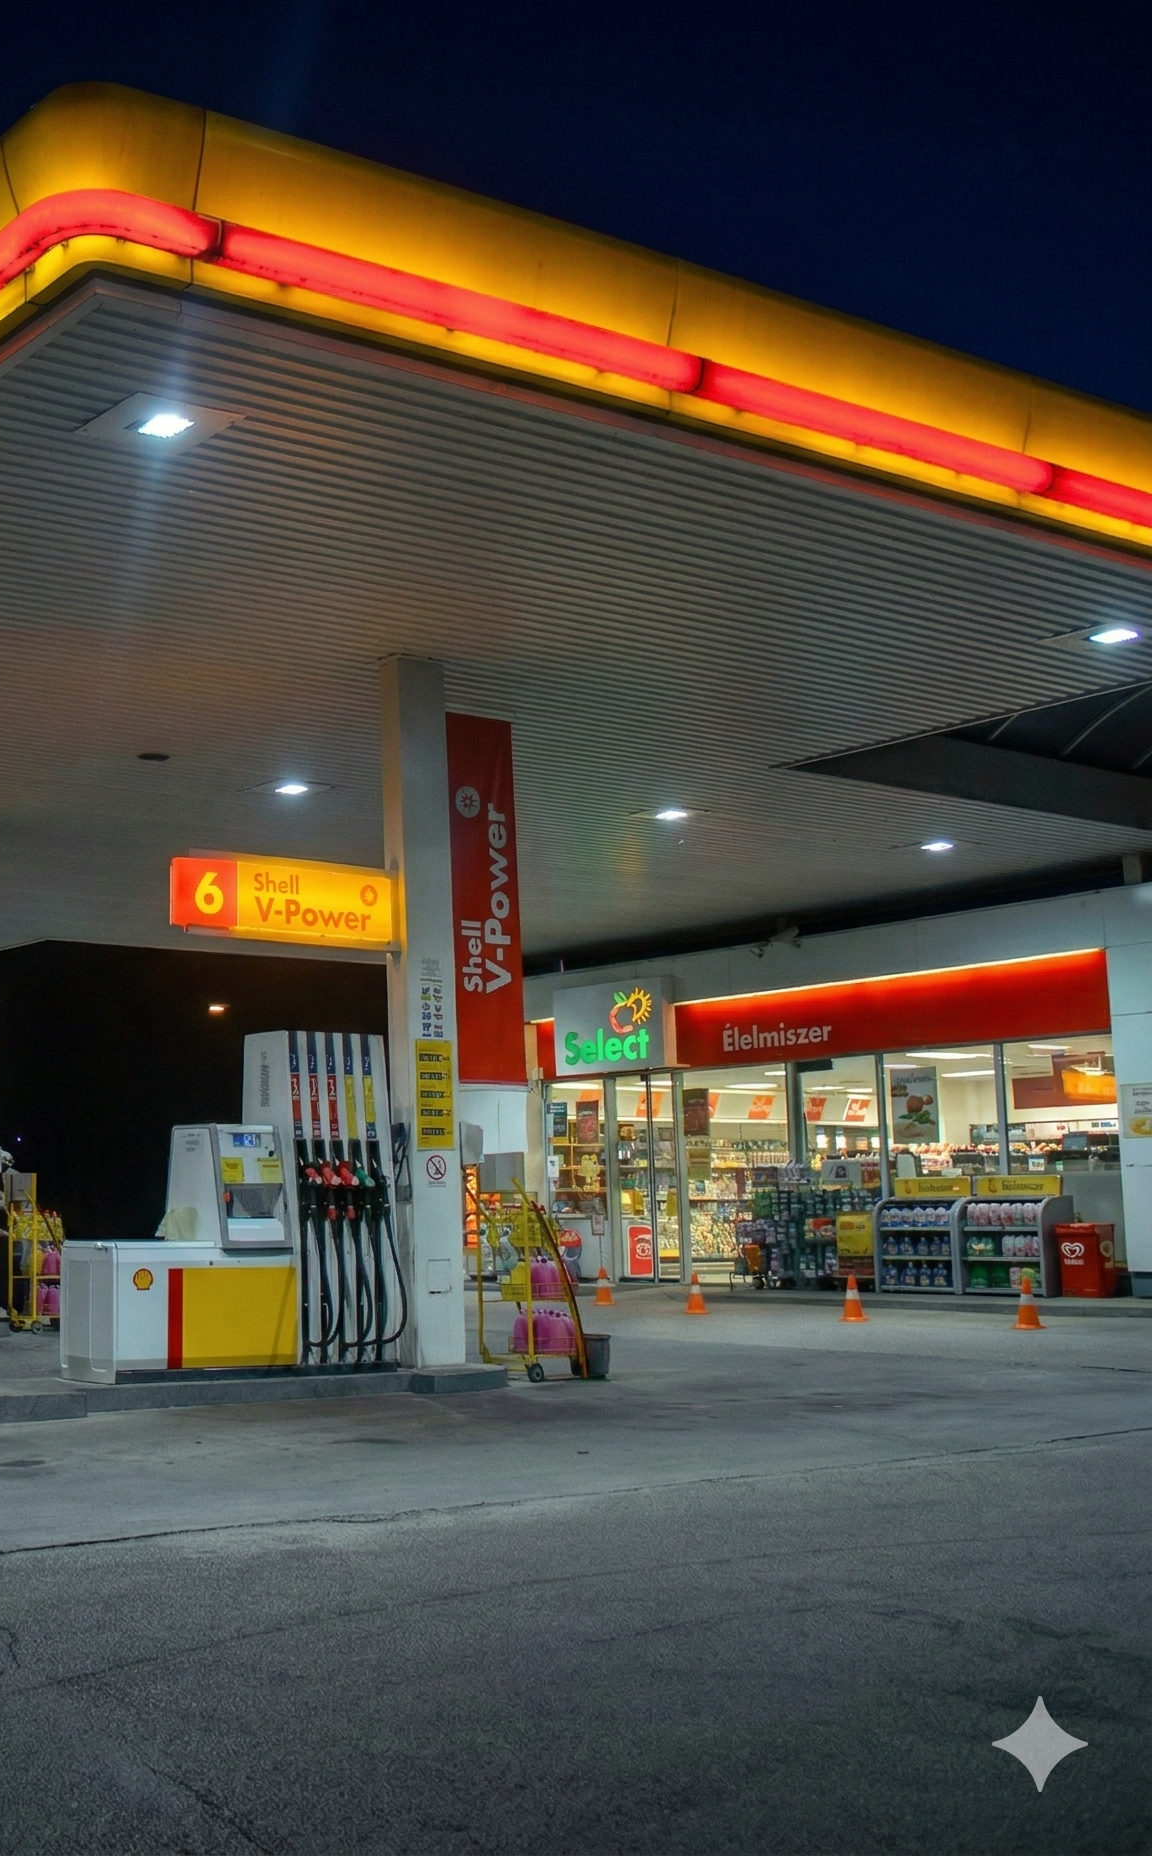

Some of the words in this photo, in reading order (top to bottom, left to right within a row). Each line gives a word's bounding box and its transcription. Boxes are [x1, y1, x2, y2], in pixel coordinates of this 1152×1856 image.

[195, 871, 224, 915] 6
[254, 872, 299, 895] Shell
[484, 802, 512, 994] V-Power
[254, 896, 371, 931] V-Power
[461, 919, 483, 993] Shell
[564, 1028, 649, 1066] Select
[723, 1023, 832, 1052] Élelmiszer
